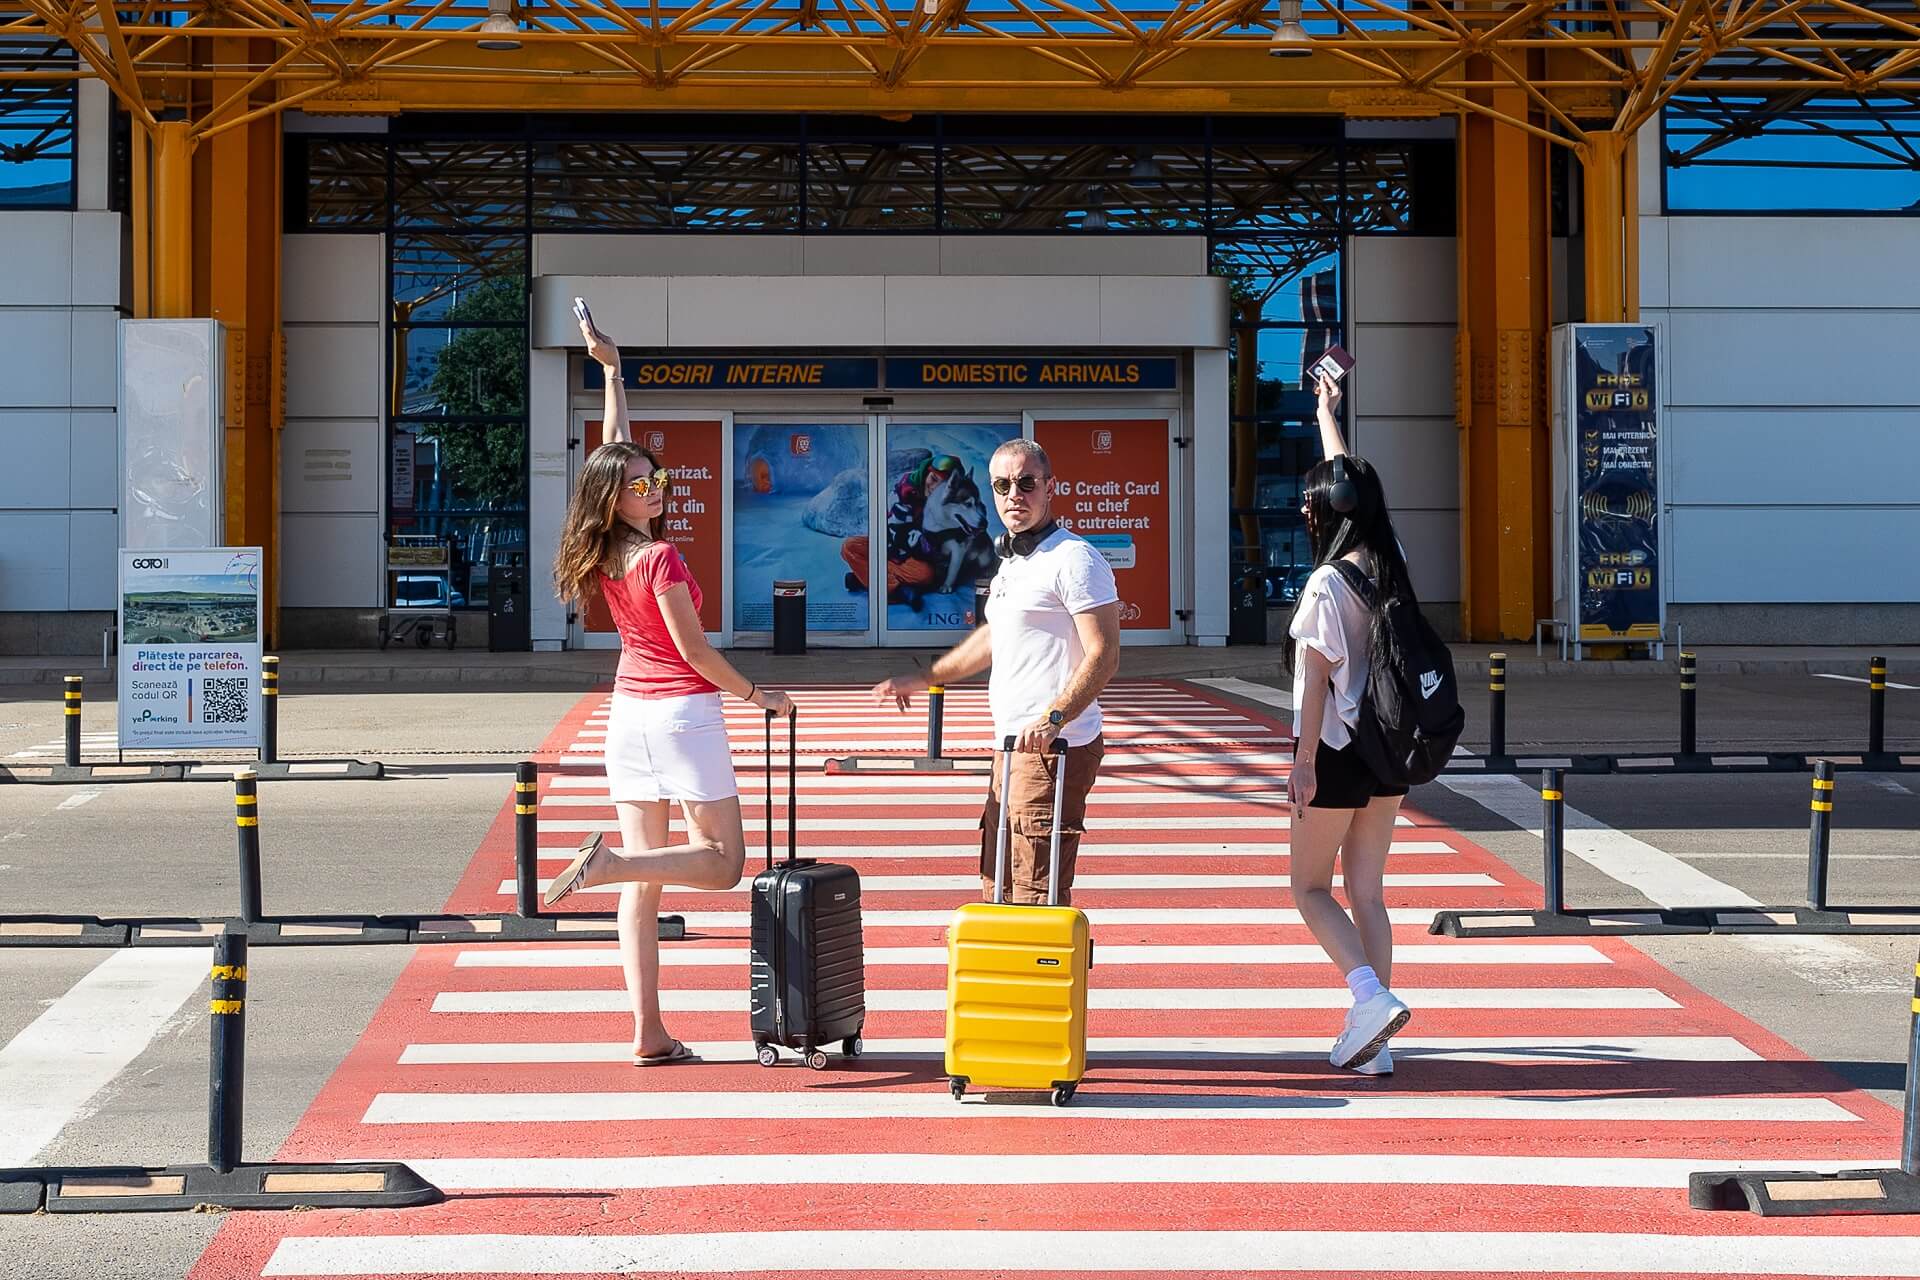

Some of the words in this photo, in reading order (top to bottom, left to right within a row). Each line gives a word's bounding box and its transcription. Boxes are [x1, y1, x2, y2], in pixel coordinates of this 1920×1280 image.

[639, 365, 713, 384] SOSIRI
[727, 365, 823, 384] INTERNE
[922, 364, 1028, 383] DOMESTIC
[1039, 364, 1139, 383] ARRIVALS
[1596, 374, 1641, 385] FREE
[1636, 391, 1645, 406] 6
[1602, 431, 1616, 440] MAI
[668, 464, 713, 480] erizat.
[672, 485, 691, 497] nu
[1075, 481, 1121, 496] Credit
[1124, 481, 1160, 496] Card
[682, 499, 705, 514] din
[1075, 501, 1093, 513] cu
[1096, 498, 1130, 513] chef
[666, 517, 693, 531] rat.
[1056, 515, 1073, 529] de
[1077, 514, 1150, 529] cutreierat
[132, 558, 163, 569] GOTO
[1599, 553, 1643, 564] FREE
[1638, 571, 1647, 584] 6
[927, 613, 960, 625] ING
[138, 651, 186, 662] Plătește
[188, 651, 243, 662] parcarea,
[132, 661, 166, 672] direct
[168, 660, 184, 671] de
[186, 662, 201, 673] pe
[203, 661, 249, 671] telefon.
[131, 680, 178, 690] Scanează
[131, 690, 159, 700] codul
[161, 690, 178, 700] QR
